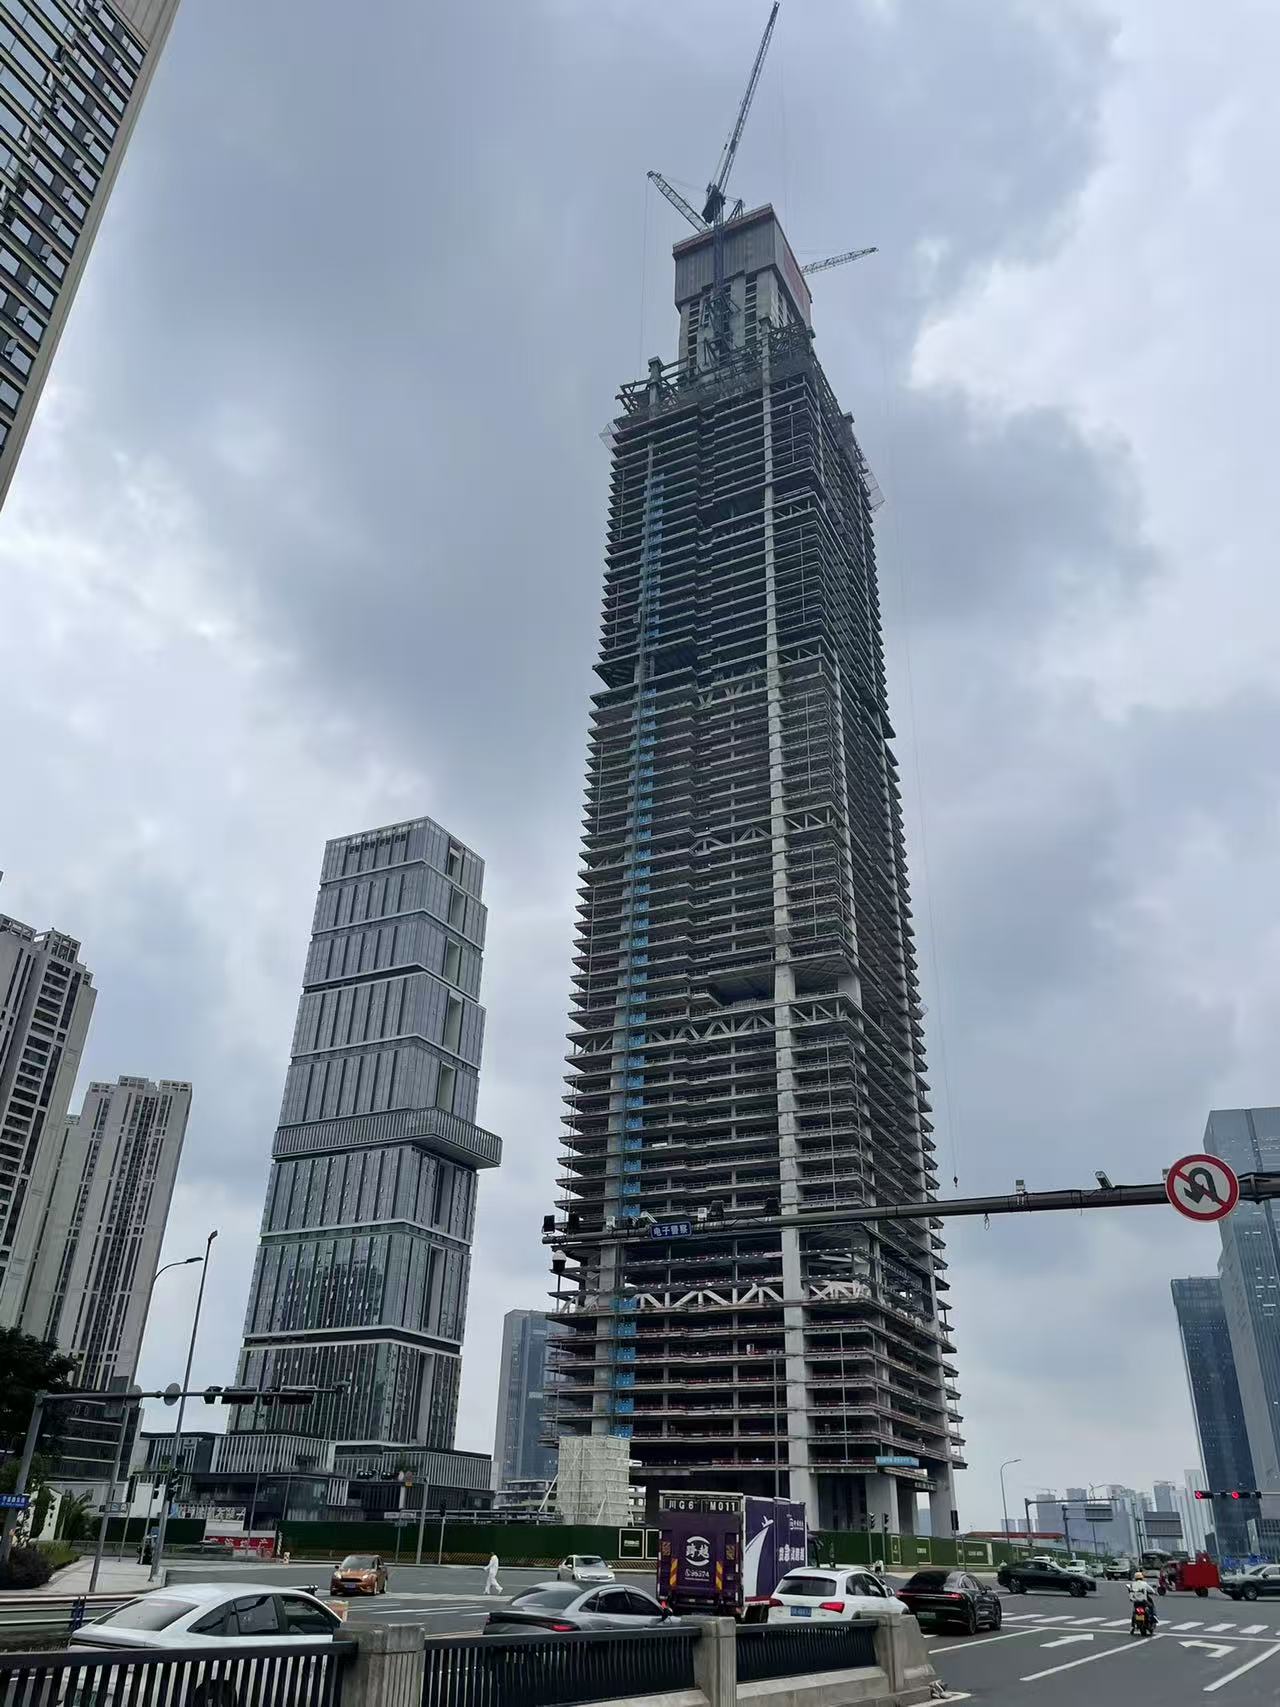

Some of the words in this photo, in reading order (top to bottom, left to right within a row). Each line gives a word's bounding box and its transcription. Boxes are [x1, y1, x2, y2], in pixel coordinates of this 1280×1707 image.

[653, 1224, 688, 1236] 电子警察
[686, 1543, 710, 1558] 跨越
